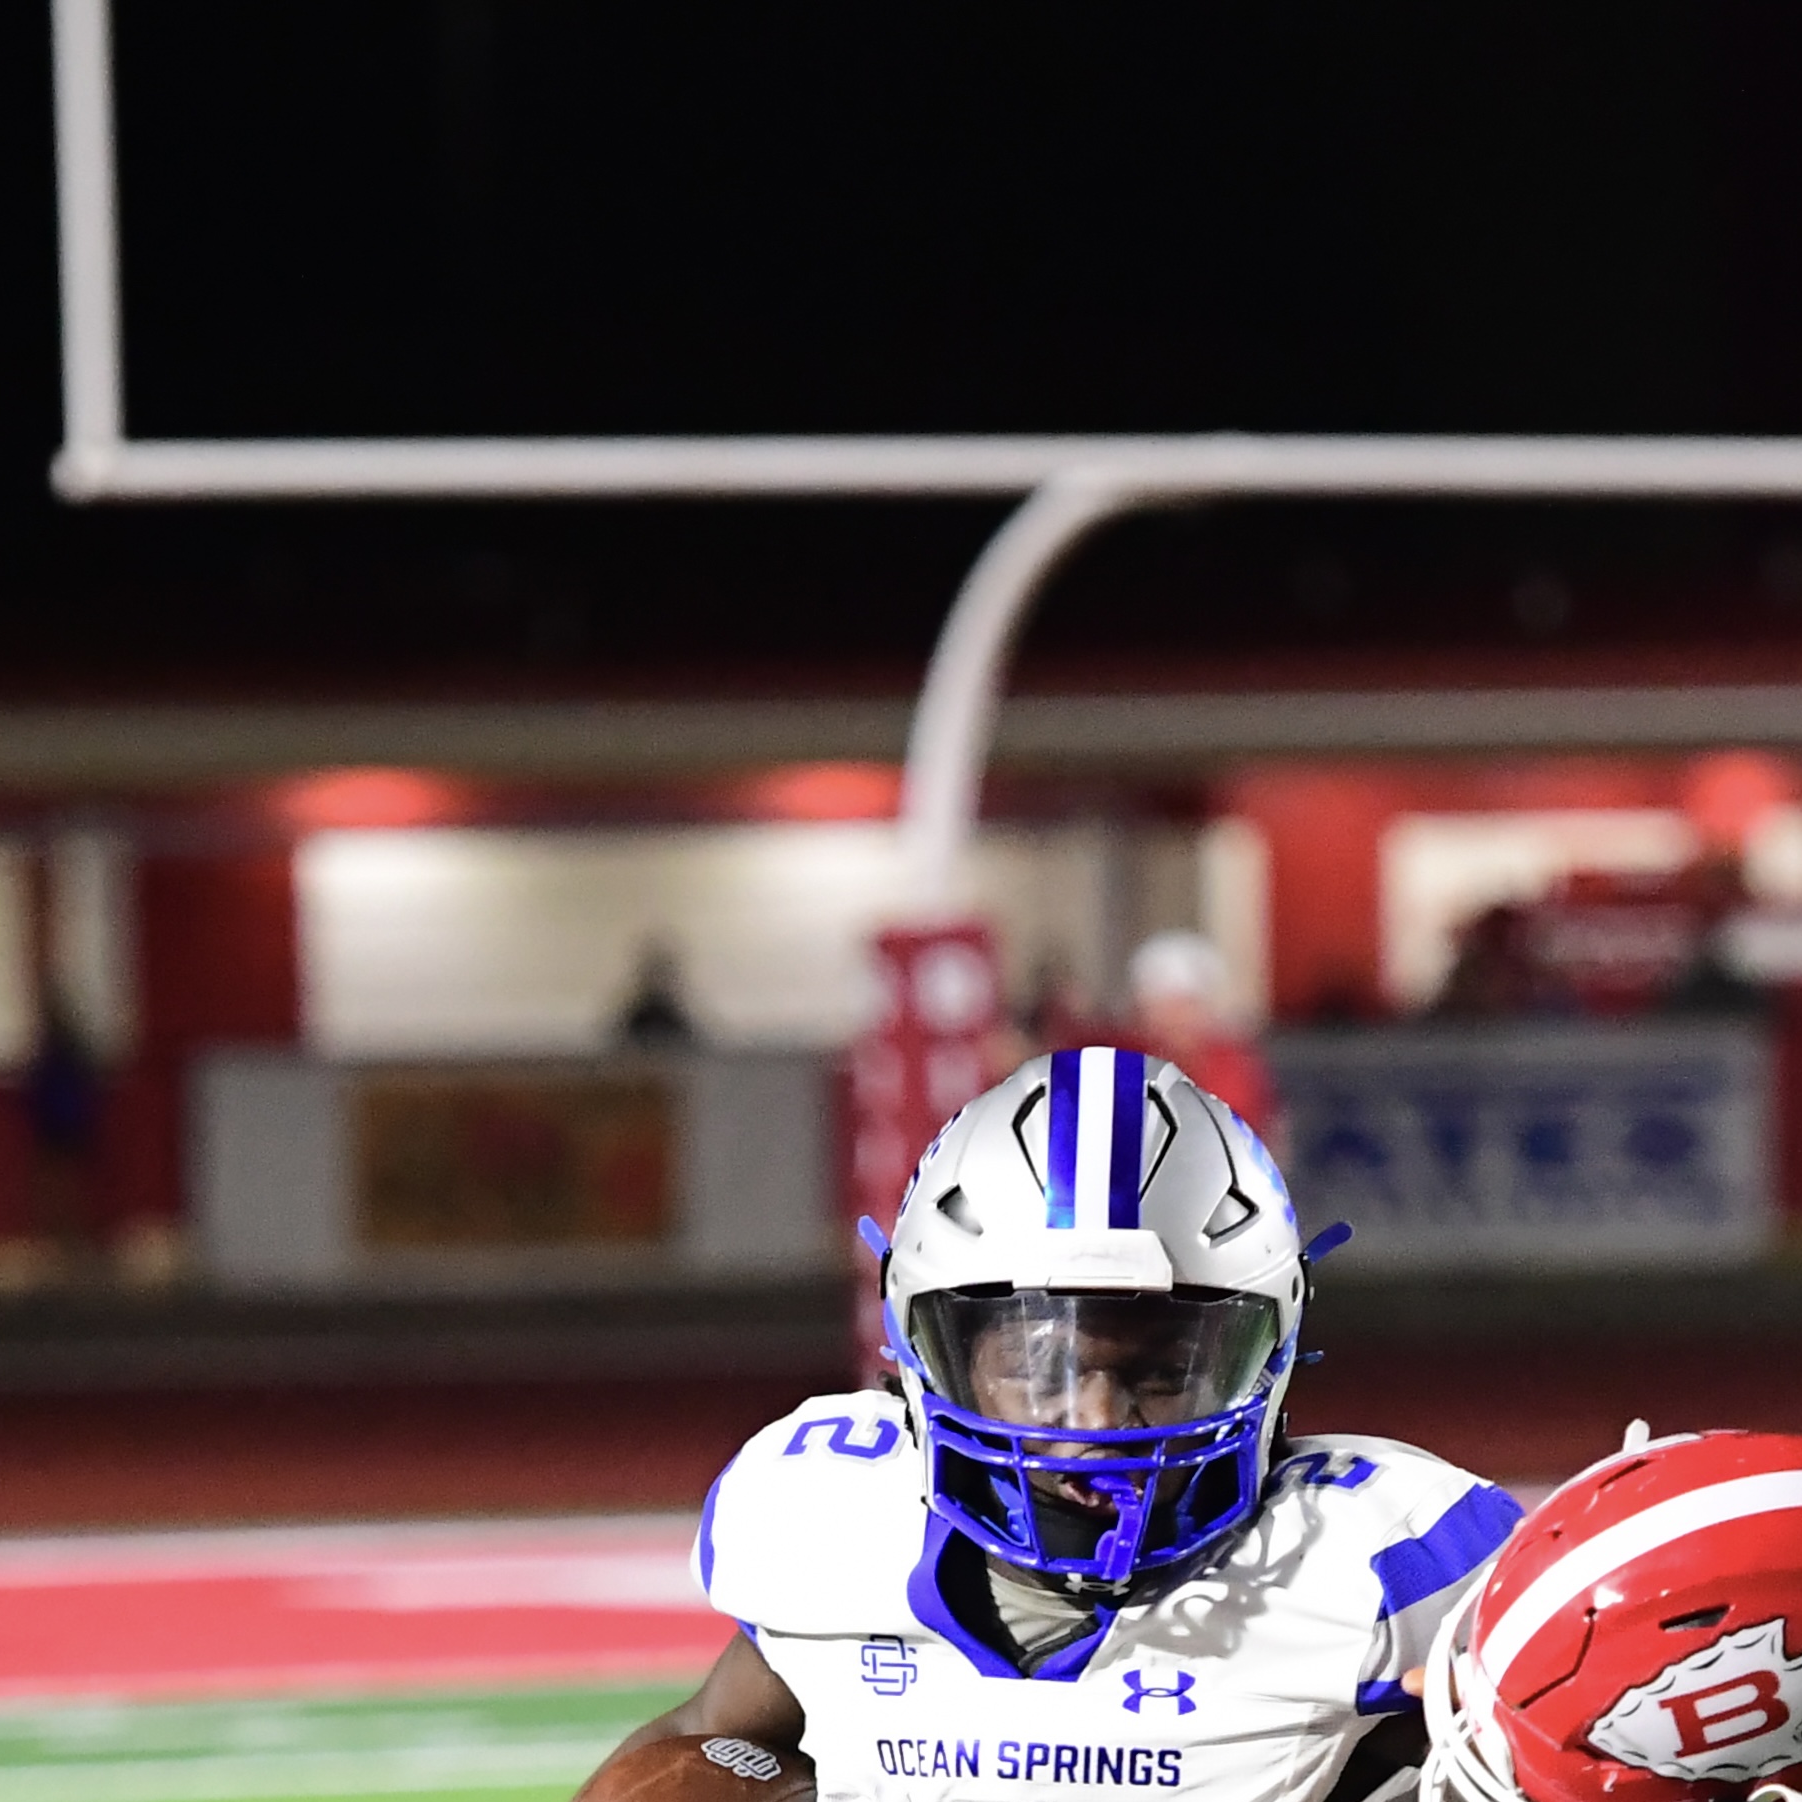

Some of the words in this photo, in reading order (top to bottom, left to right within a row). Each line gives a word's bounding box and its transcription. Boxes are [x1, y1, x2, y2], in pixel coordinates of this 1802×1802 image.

[781, 1414, 904, 1463] 2
[1658, 1669, 1791, 1759] B
[877, 1738, 981, 1778] OCEAN
[996, 1739, 1183, 1787] SPRINGS
